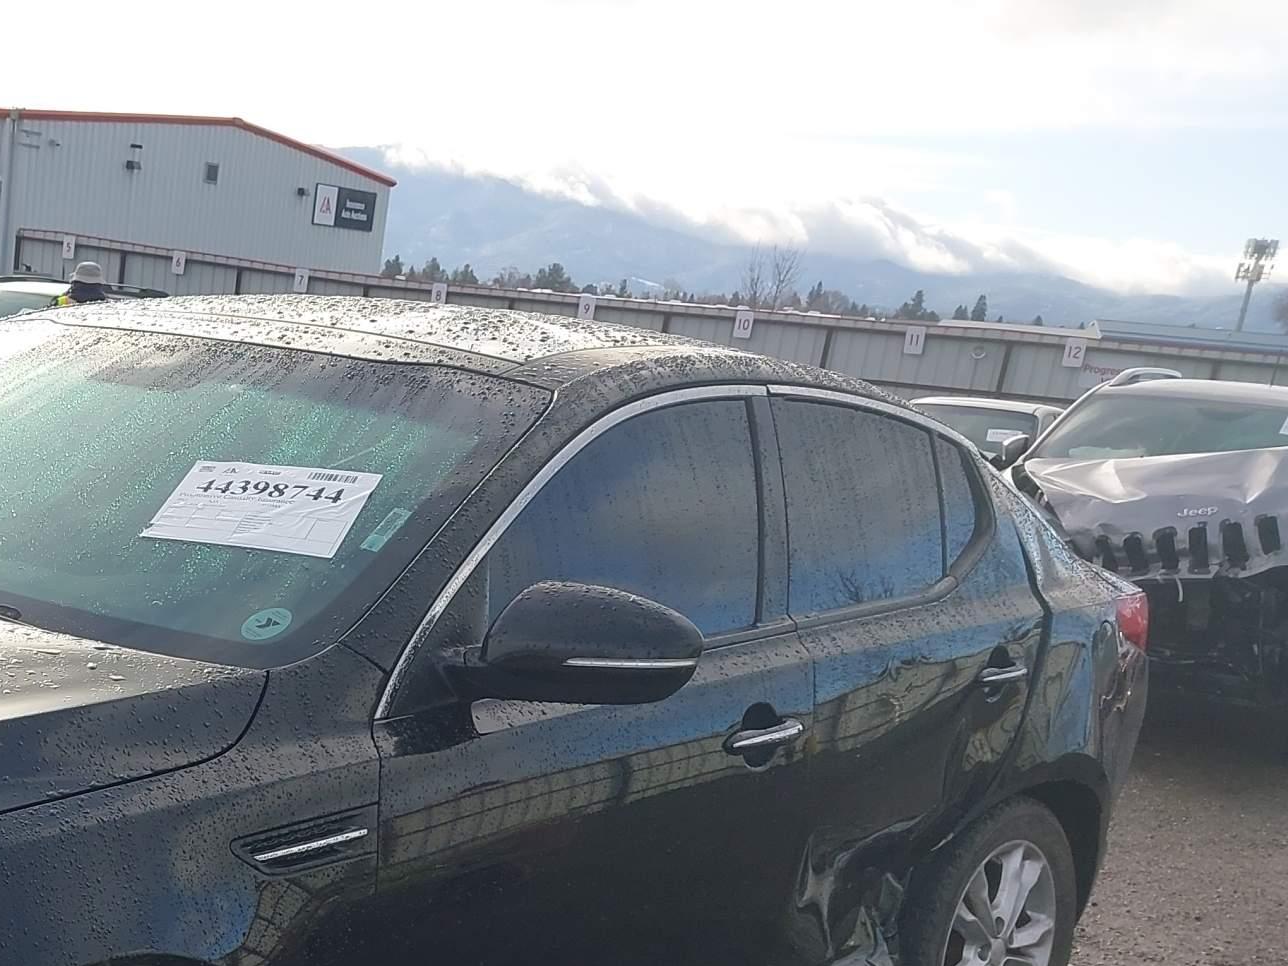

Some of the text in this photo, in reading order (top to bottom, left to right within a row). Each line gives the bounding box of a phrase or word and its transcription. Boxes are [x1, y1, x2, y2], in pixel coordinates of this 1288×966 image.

[66, 242, 72, 253] 5
[175, 256, 182, 268] 6
[298, 274, 305, 285] 7
[435, 290, 443, 301] 8
[582, 302, 592, 314] 9
[737, 317, 751, 331] 10
[908, 334, 921, 347] 11
[1067, 345, 1083, 360] 12
[196, 479, 345, 504] 44398744
[1176, 505, 1218, 518] Jeep
